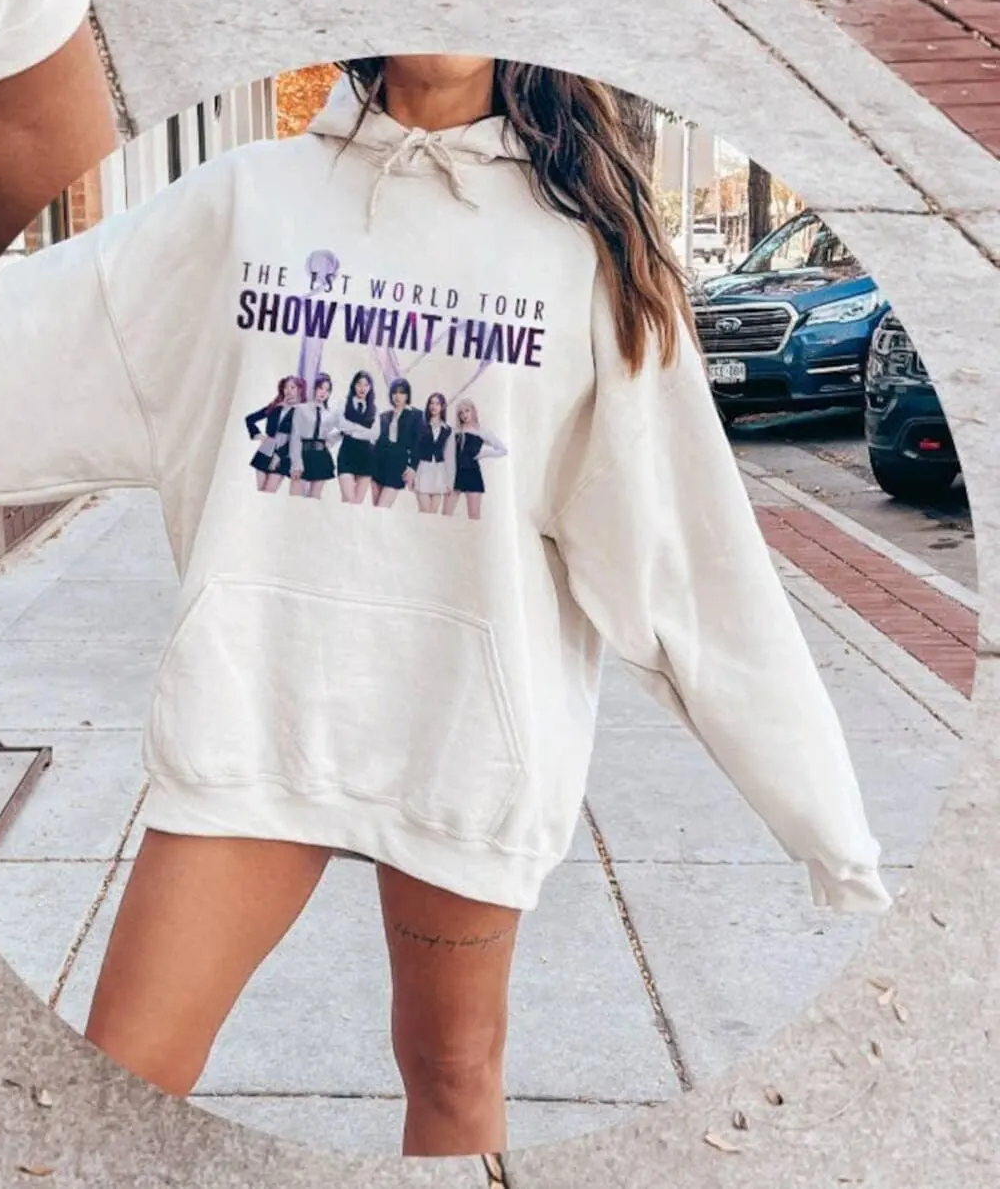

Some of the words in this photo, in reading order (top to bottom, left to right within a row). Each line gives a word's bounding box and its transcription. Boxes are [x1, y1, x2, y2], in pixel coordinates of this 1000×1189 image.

[242, 262, 289, 287] THE
[309, 272, 351, 295] 1ST
[371, 279, 458, 309] WORLD
[479, 294, 545, 321] TOUR
[236, 290, 337, 339] SHOW
[344, 303, 442, 353] WHAT
[462, 319, 545, 367] HAVE
